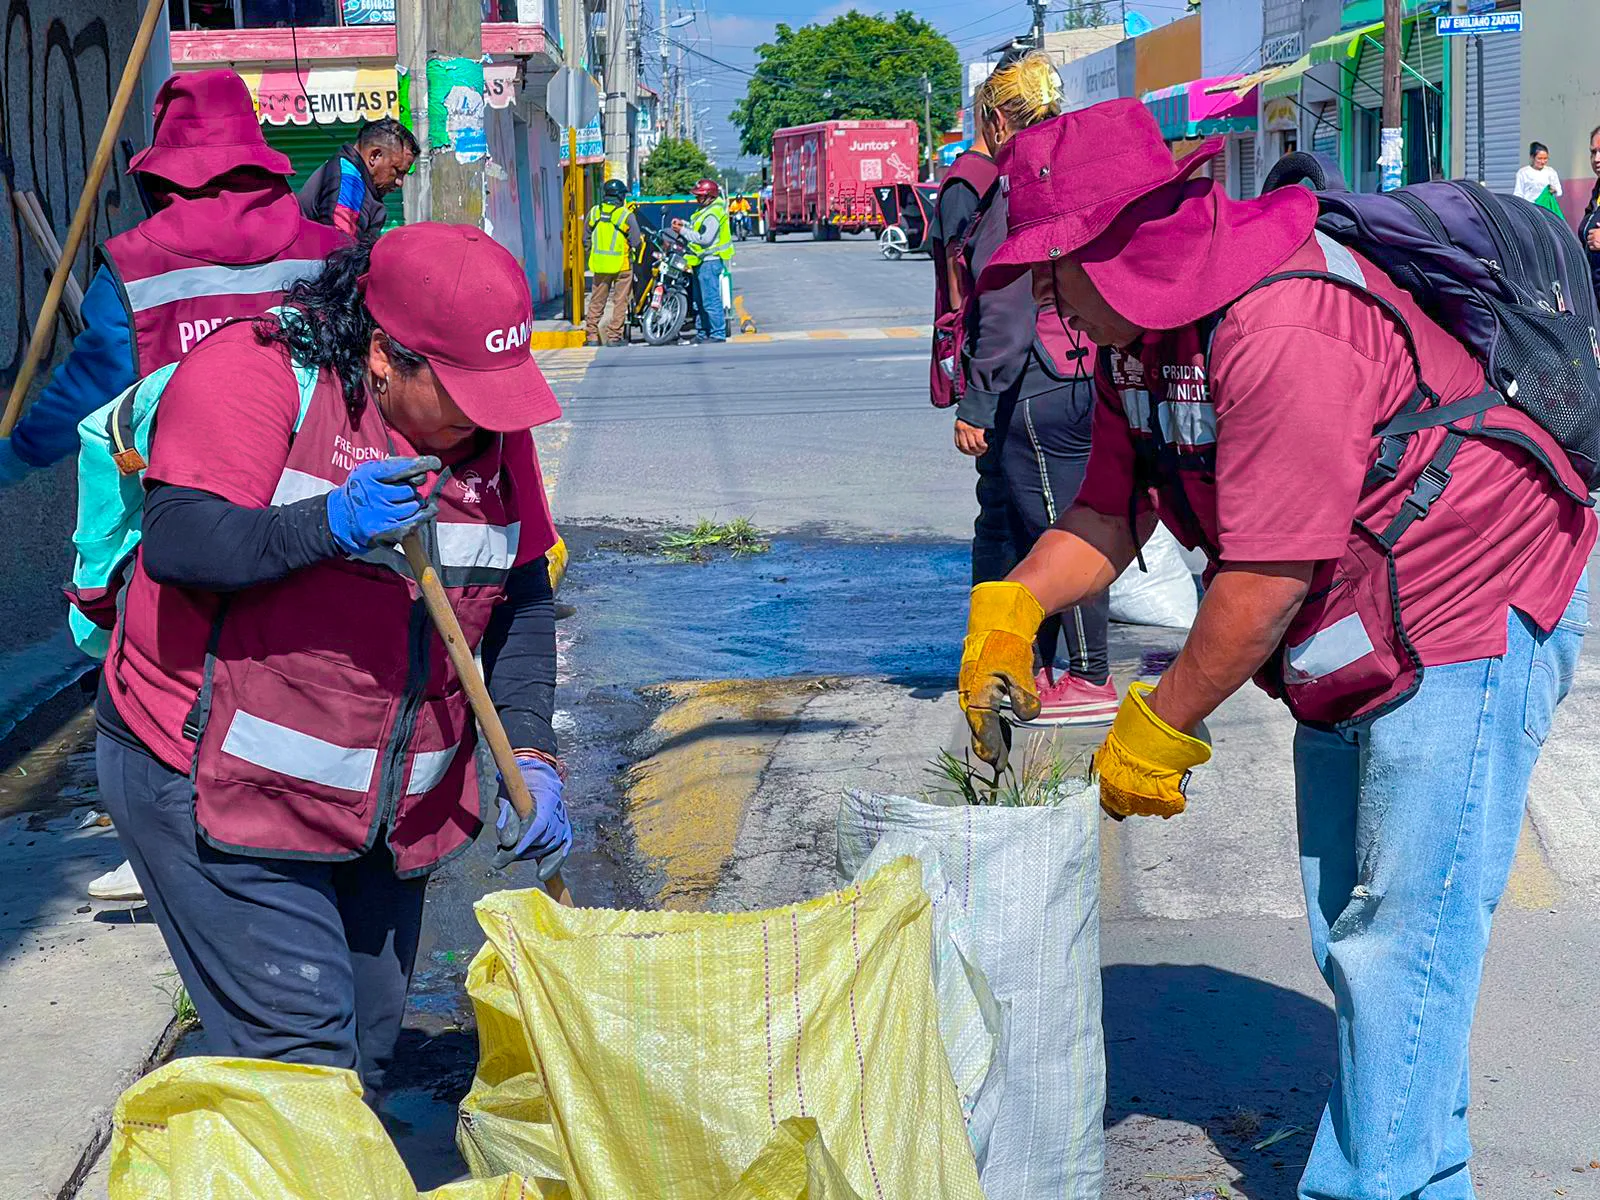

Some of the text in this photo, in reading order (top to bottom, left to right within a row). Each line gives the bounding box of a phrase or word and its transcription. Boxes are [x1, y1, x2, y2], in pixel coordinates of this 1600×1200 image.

[1440, 15, 1520, 29] AV EMILIANO ZAPATA
[294, 91, 382, 114] CEMITAS
